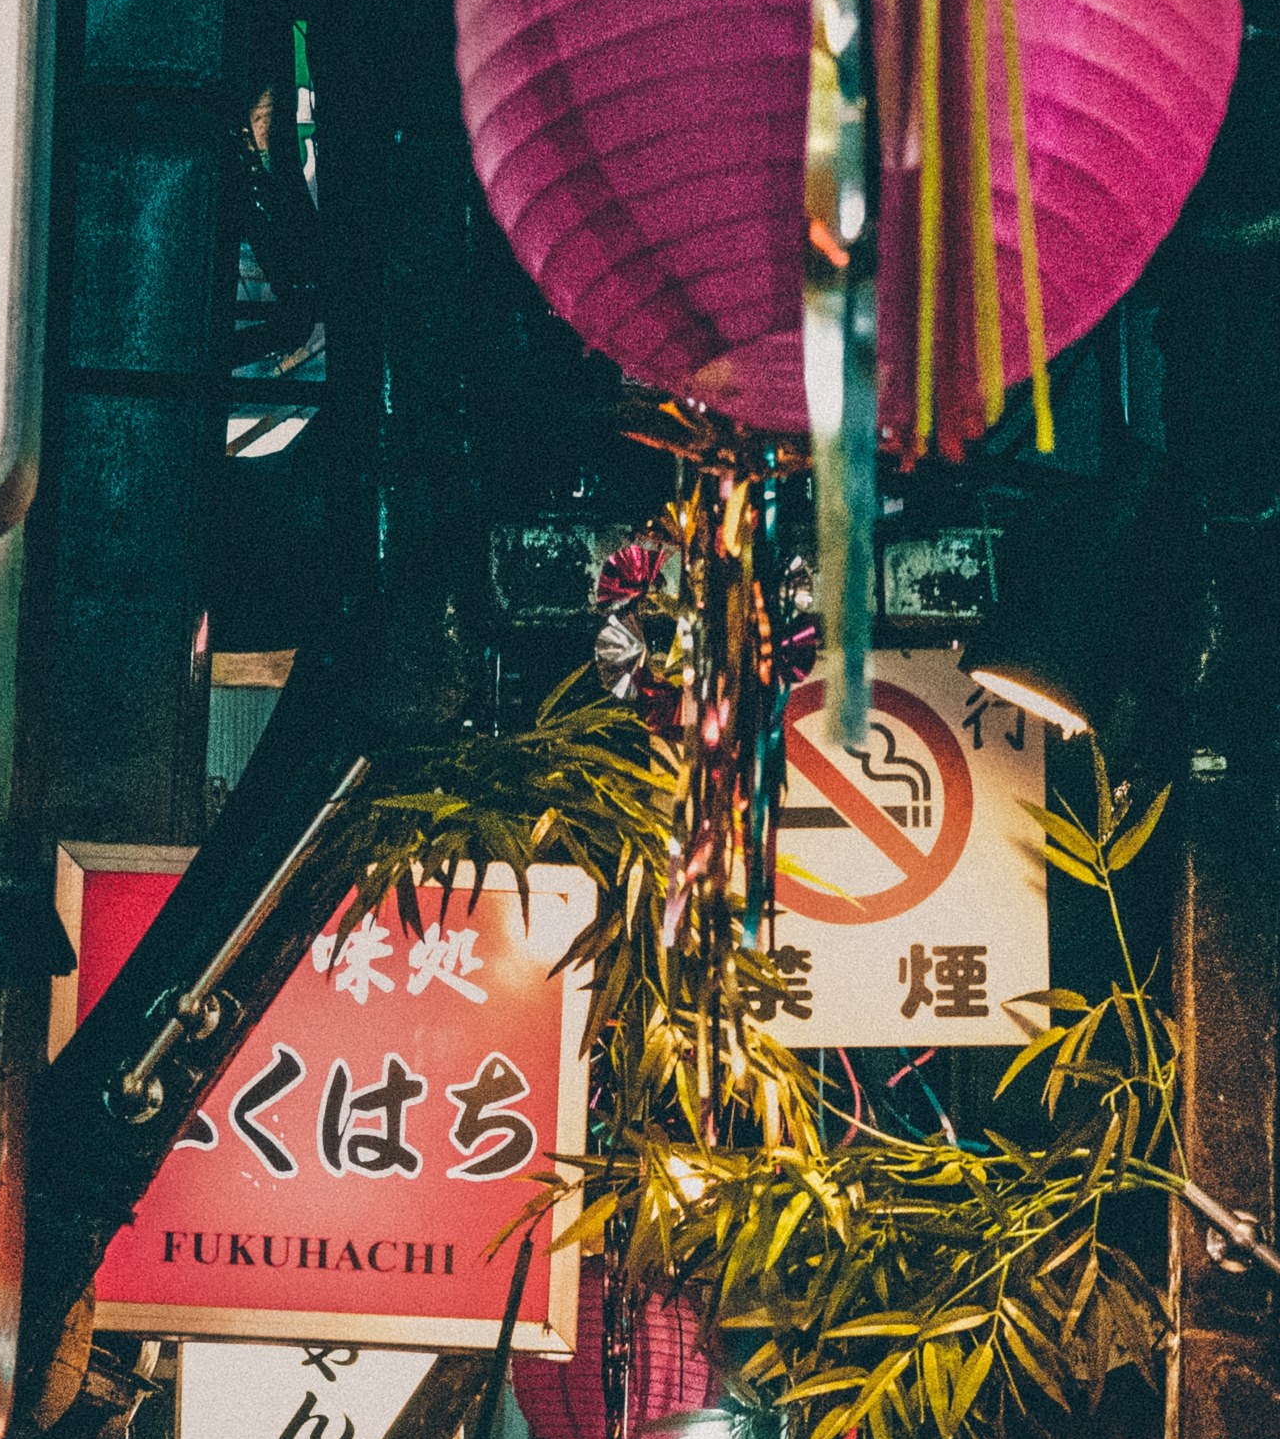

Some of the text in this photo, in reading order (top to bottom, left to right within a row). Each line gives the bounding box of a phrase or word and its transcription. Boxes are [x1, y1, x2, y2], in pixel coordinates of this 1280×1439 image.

[173, 1042, 538, 1181] くはち
[162, 1231, 455, 1275] FUKUHACHI
